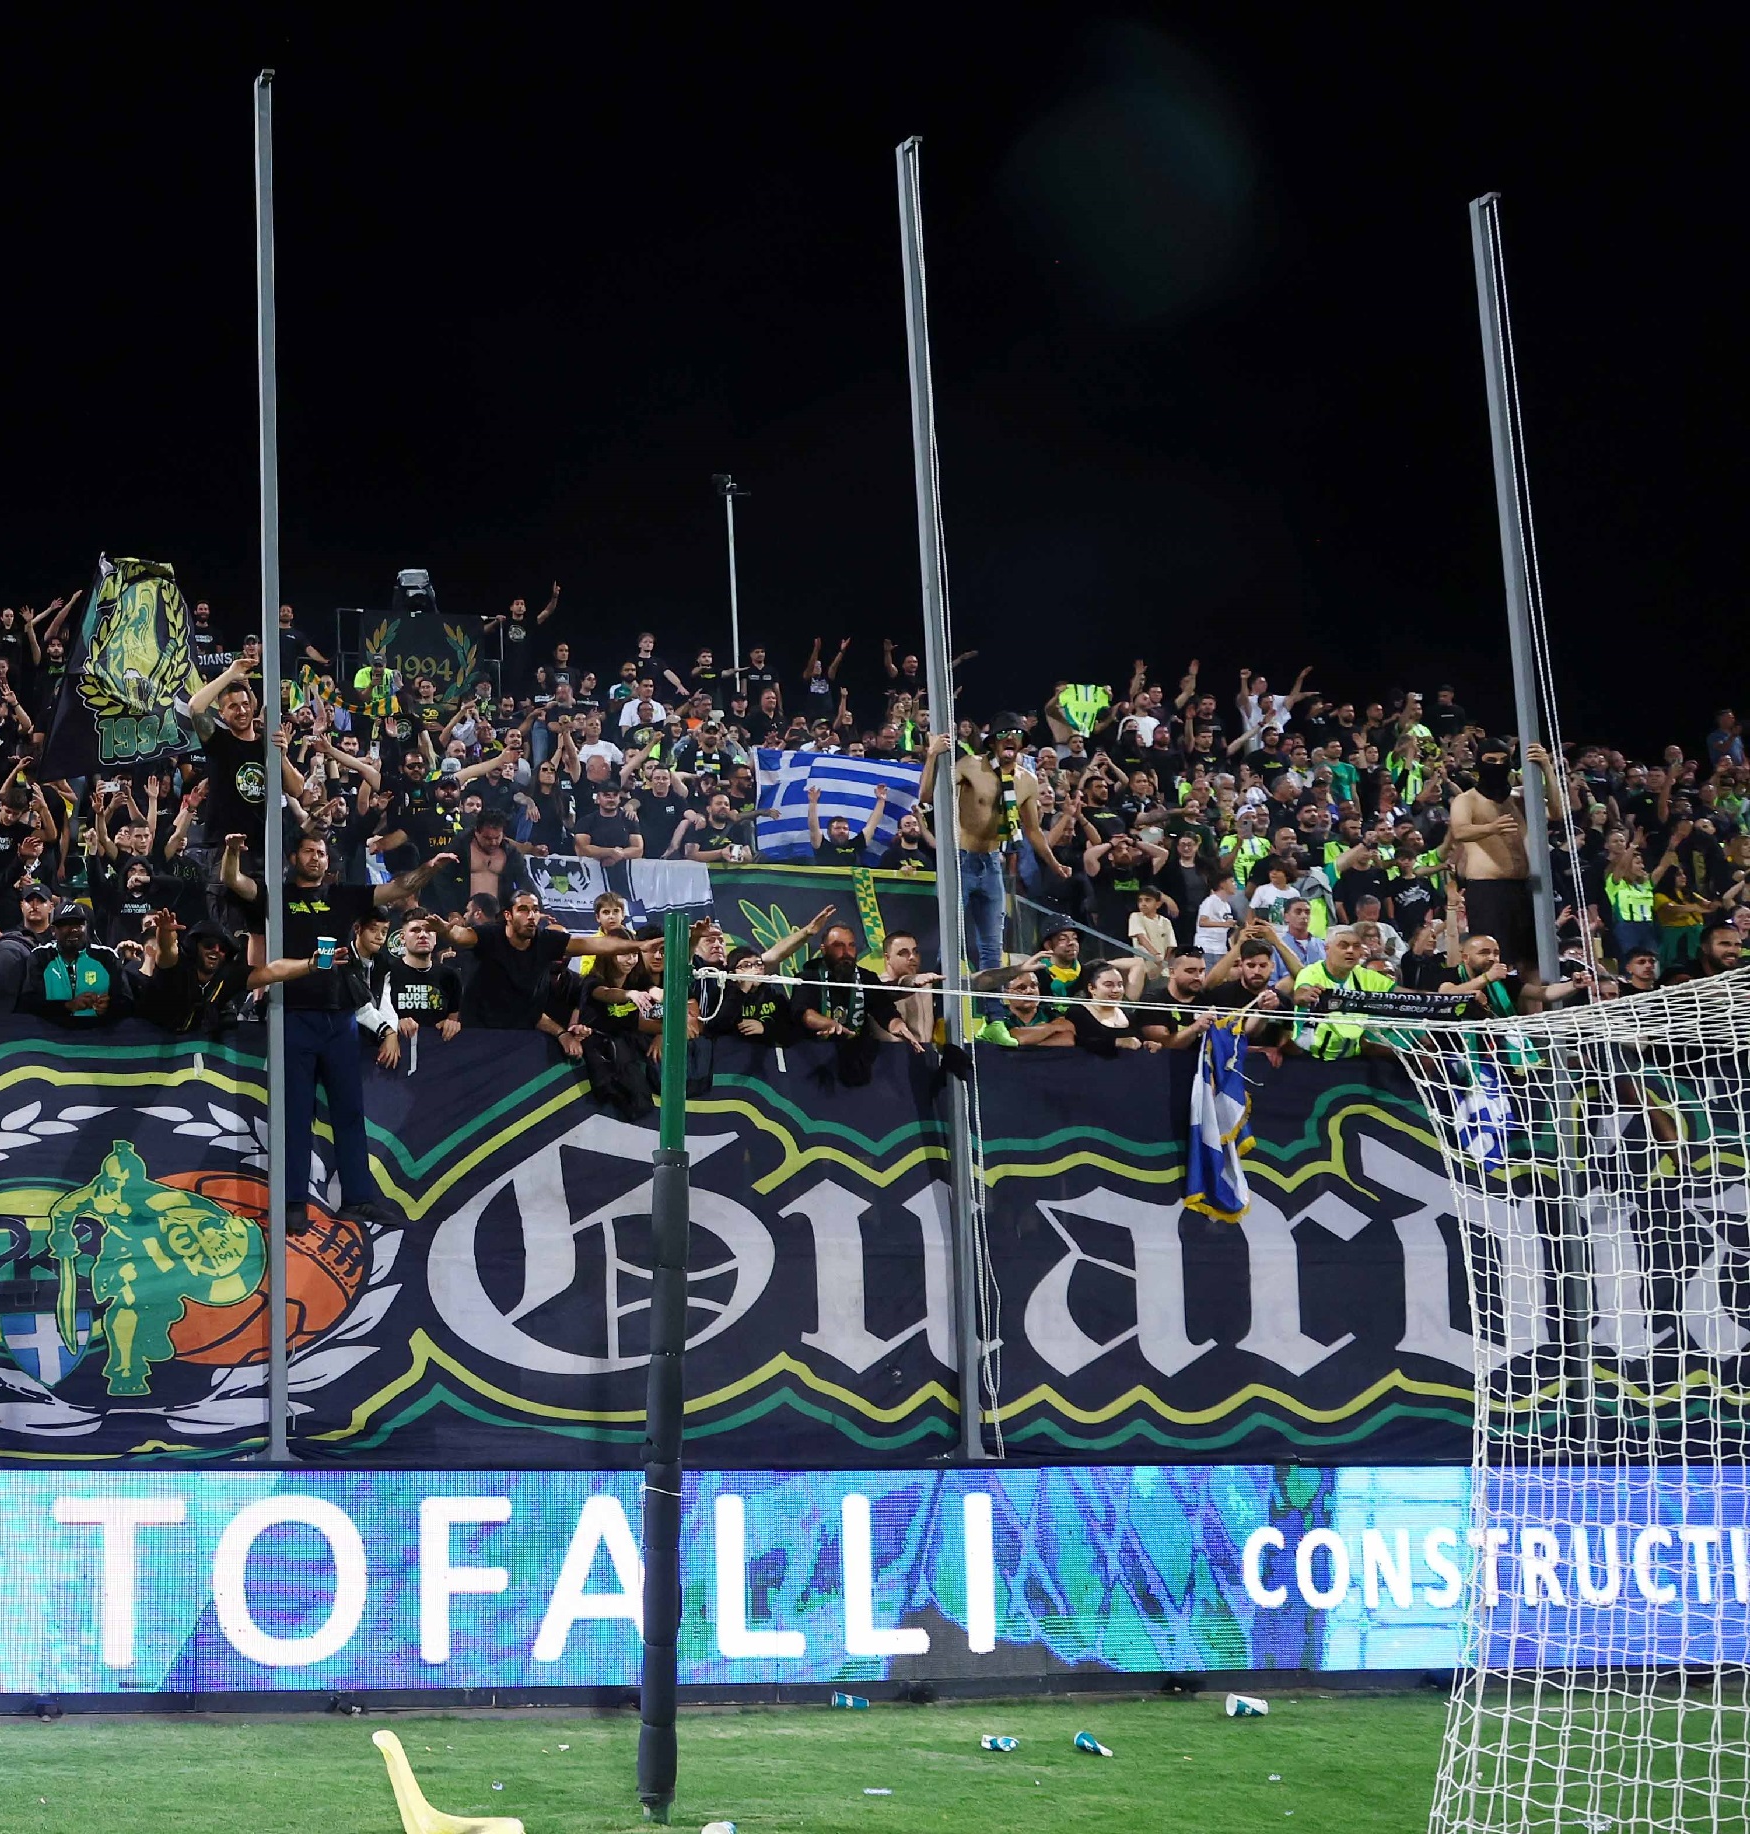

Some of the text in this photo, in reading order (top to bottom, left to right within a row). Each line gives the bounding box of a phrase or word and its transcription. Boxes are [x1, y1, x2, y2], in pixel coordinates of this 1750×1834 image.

[396, 654, 453, 680] 1994
[99, 708, 180, 758] 1994
[398, 992, 428, 1001] RUDE
[405, 984, 428, 993] THE
[398, 1001, 429, 1010] BOYS
[53, 1493, 996, 1667] TOFALLI
